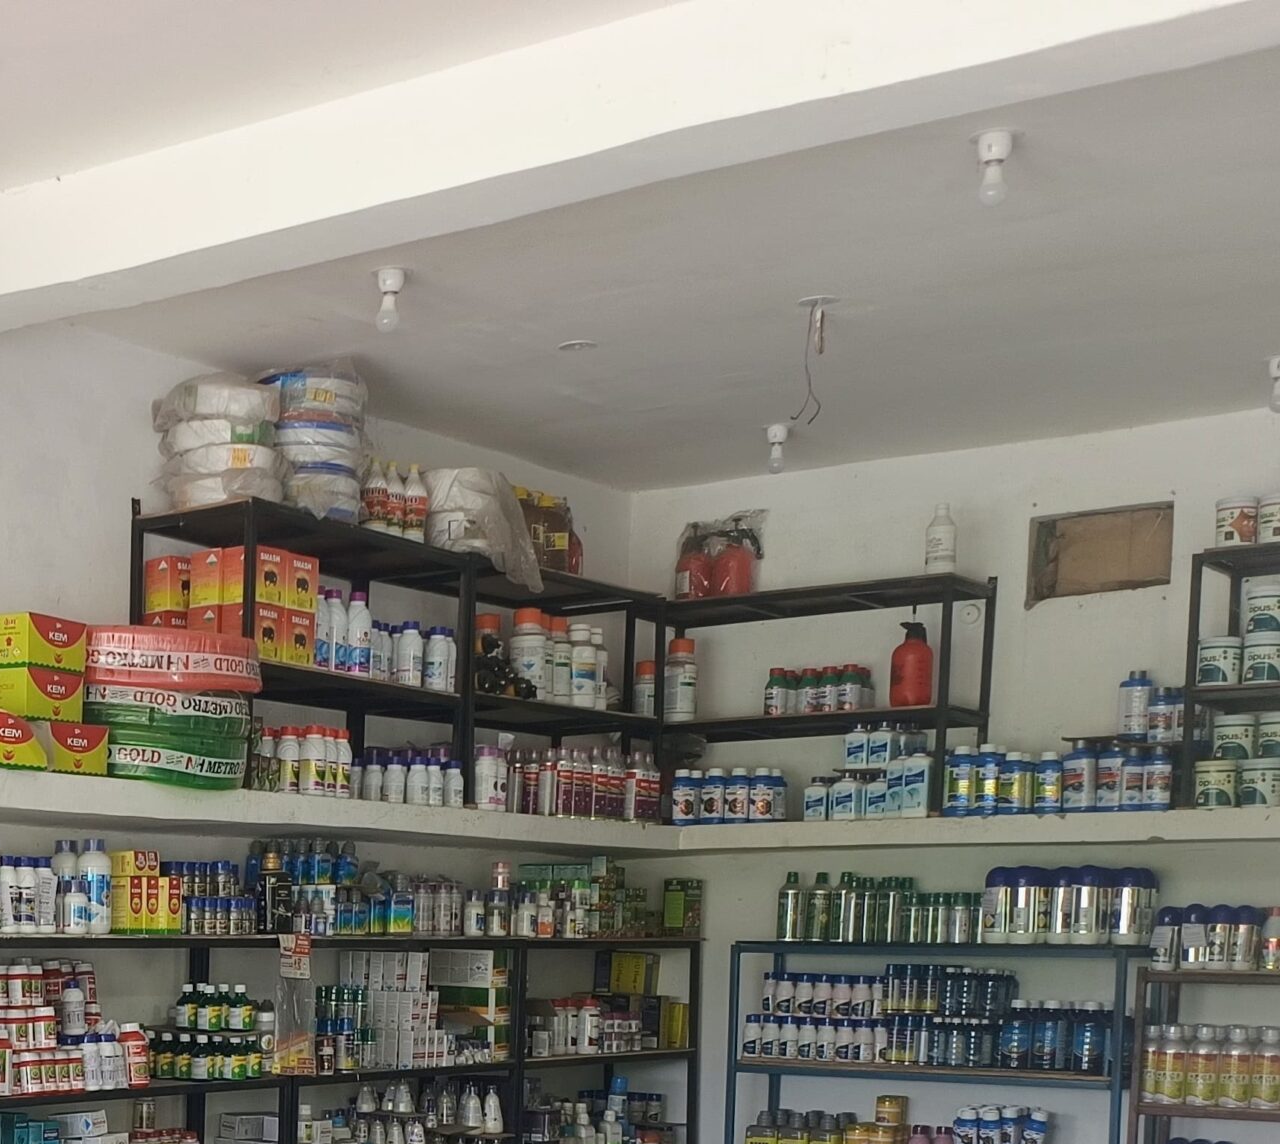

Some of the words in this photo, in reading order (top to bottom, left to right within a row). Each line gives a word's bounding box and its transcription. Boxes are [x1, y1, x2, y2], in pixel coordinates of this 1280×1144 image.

[260, 552, 280, 563] SMASH
[294, 560, 312, 571] SMASH
[259, 608, 278, 619] SMASH
[292, 616, 309, 626] SMASH
[49, 631, 68, 642] KEM
[47, 684, 65, 694] KEM
[67, 737, 88, 747] KEM
[118, 747, 161, 764] GOLD
[206, 760, 240, 775] METRO
